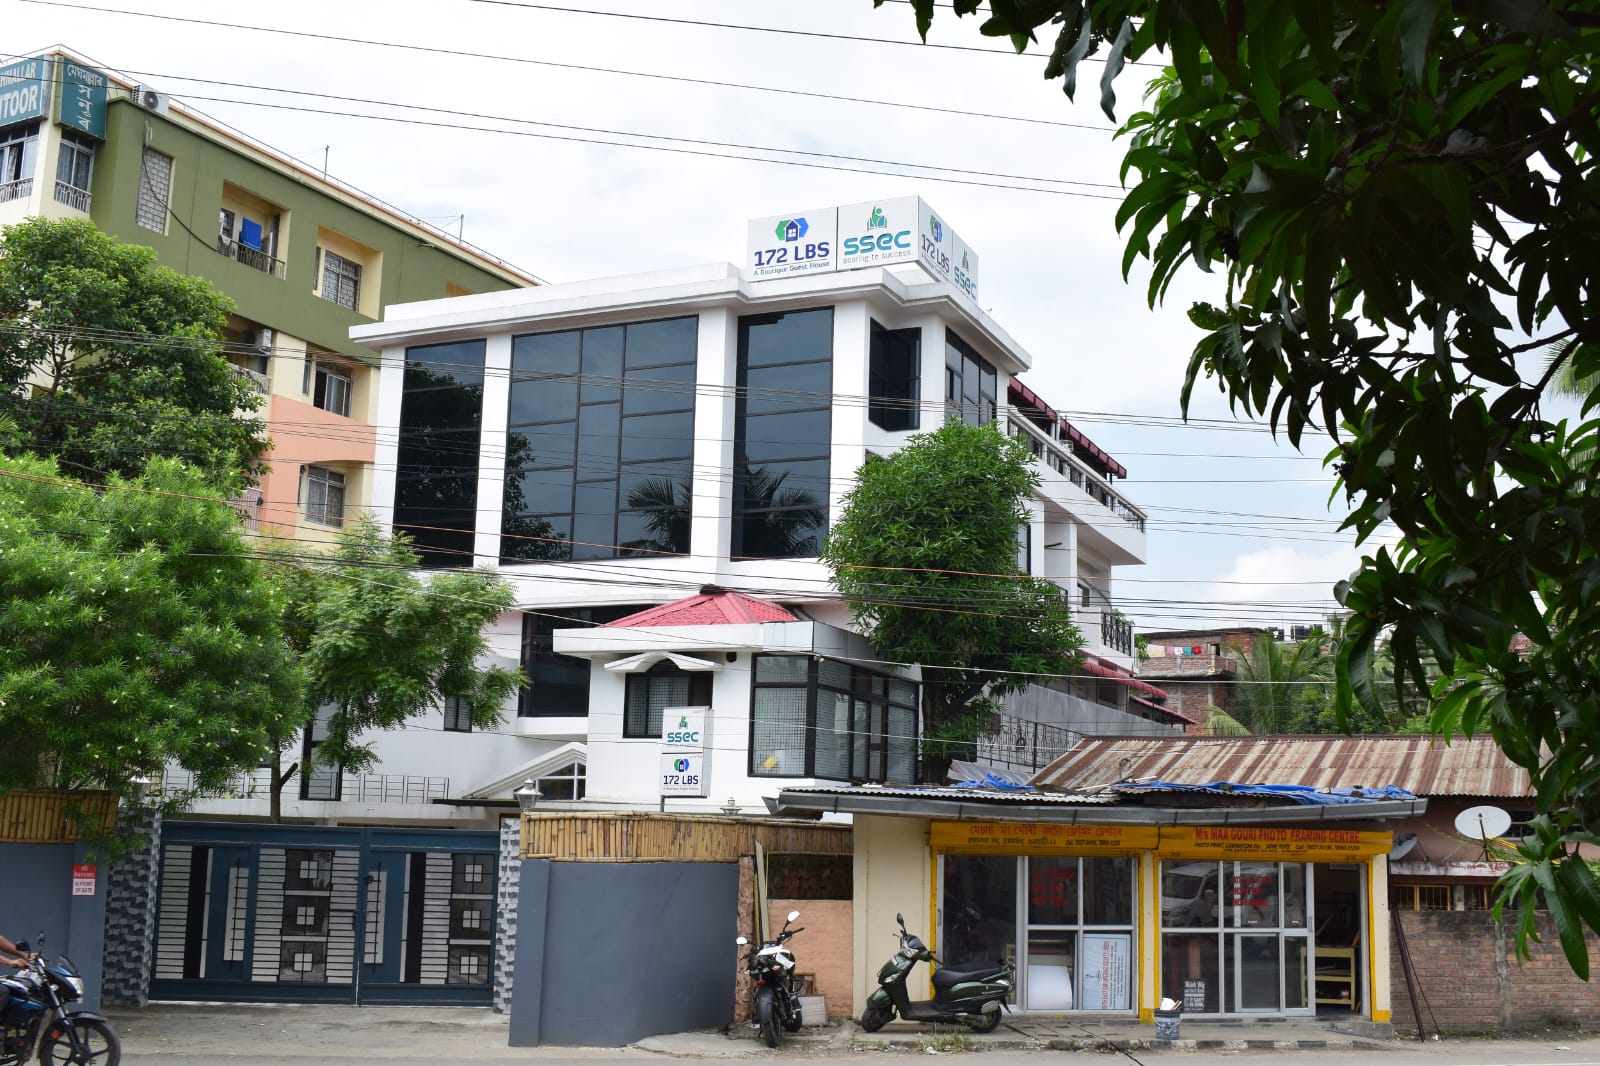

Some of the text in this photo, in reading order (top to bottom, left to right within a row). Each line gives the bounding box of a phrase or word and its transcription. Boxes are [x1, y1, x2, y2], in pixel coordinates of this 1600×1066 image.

[0, 62, 37, 87] HMALLAR
[0, 84, 38, 120] TOOR
[754, 241, 830, 267] 172 LBS
[881, 250, 911, 260] success
[921, 233, 935, 259] 172
[936, 248, 950, 273] LBS
[753, 260, 830, 277] A Boutique Guest House
[663, 775, 699, 785] 172 LBS
[1211, 829, 1228, 840] MAA
[1231, 830, 1256, 841] GOURI
[1259, 830, 1286, 841] PHOTO
[1291, 831, 1326, 842] FRAMING
[1329, 831, 1360, 843] CENTRE
